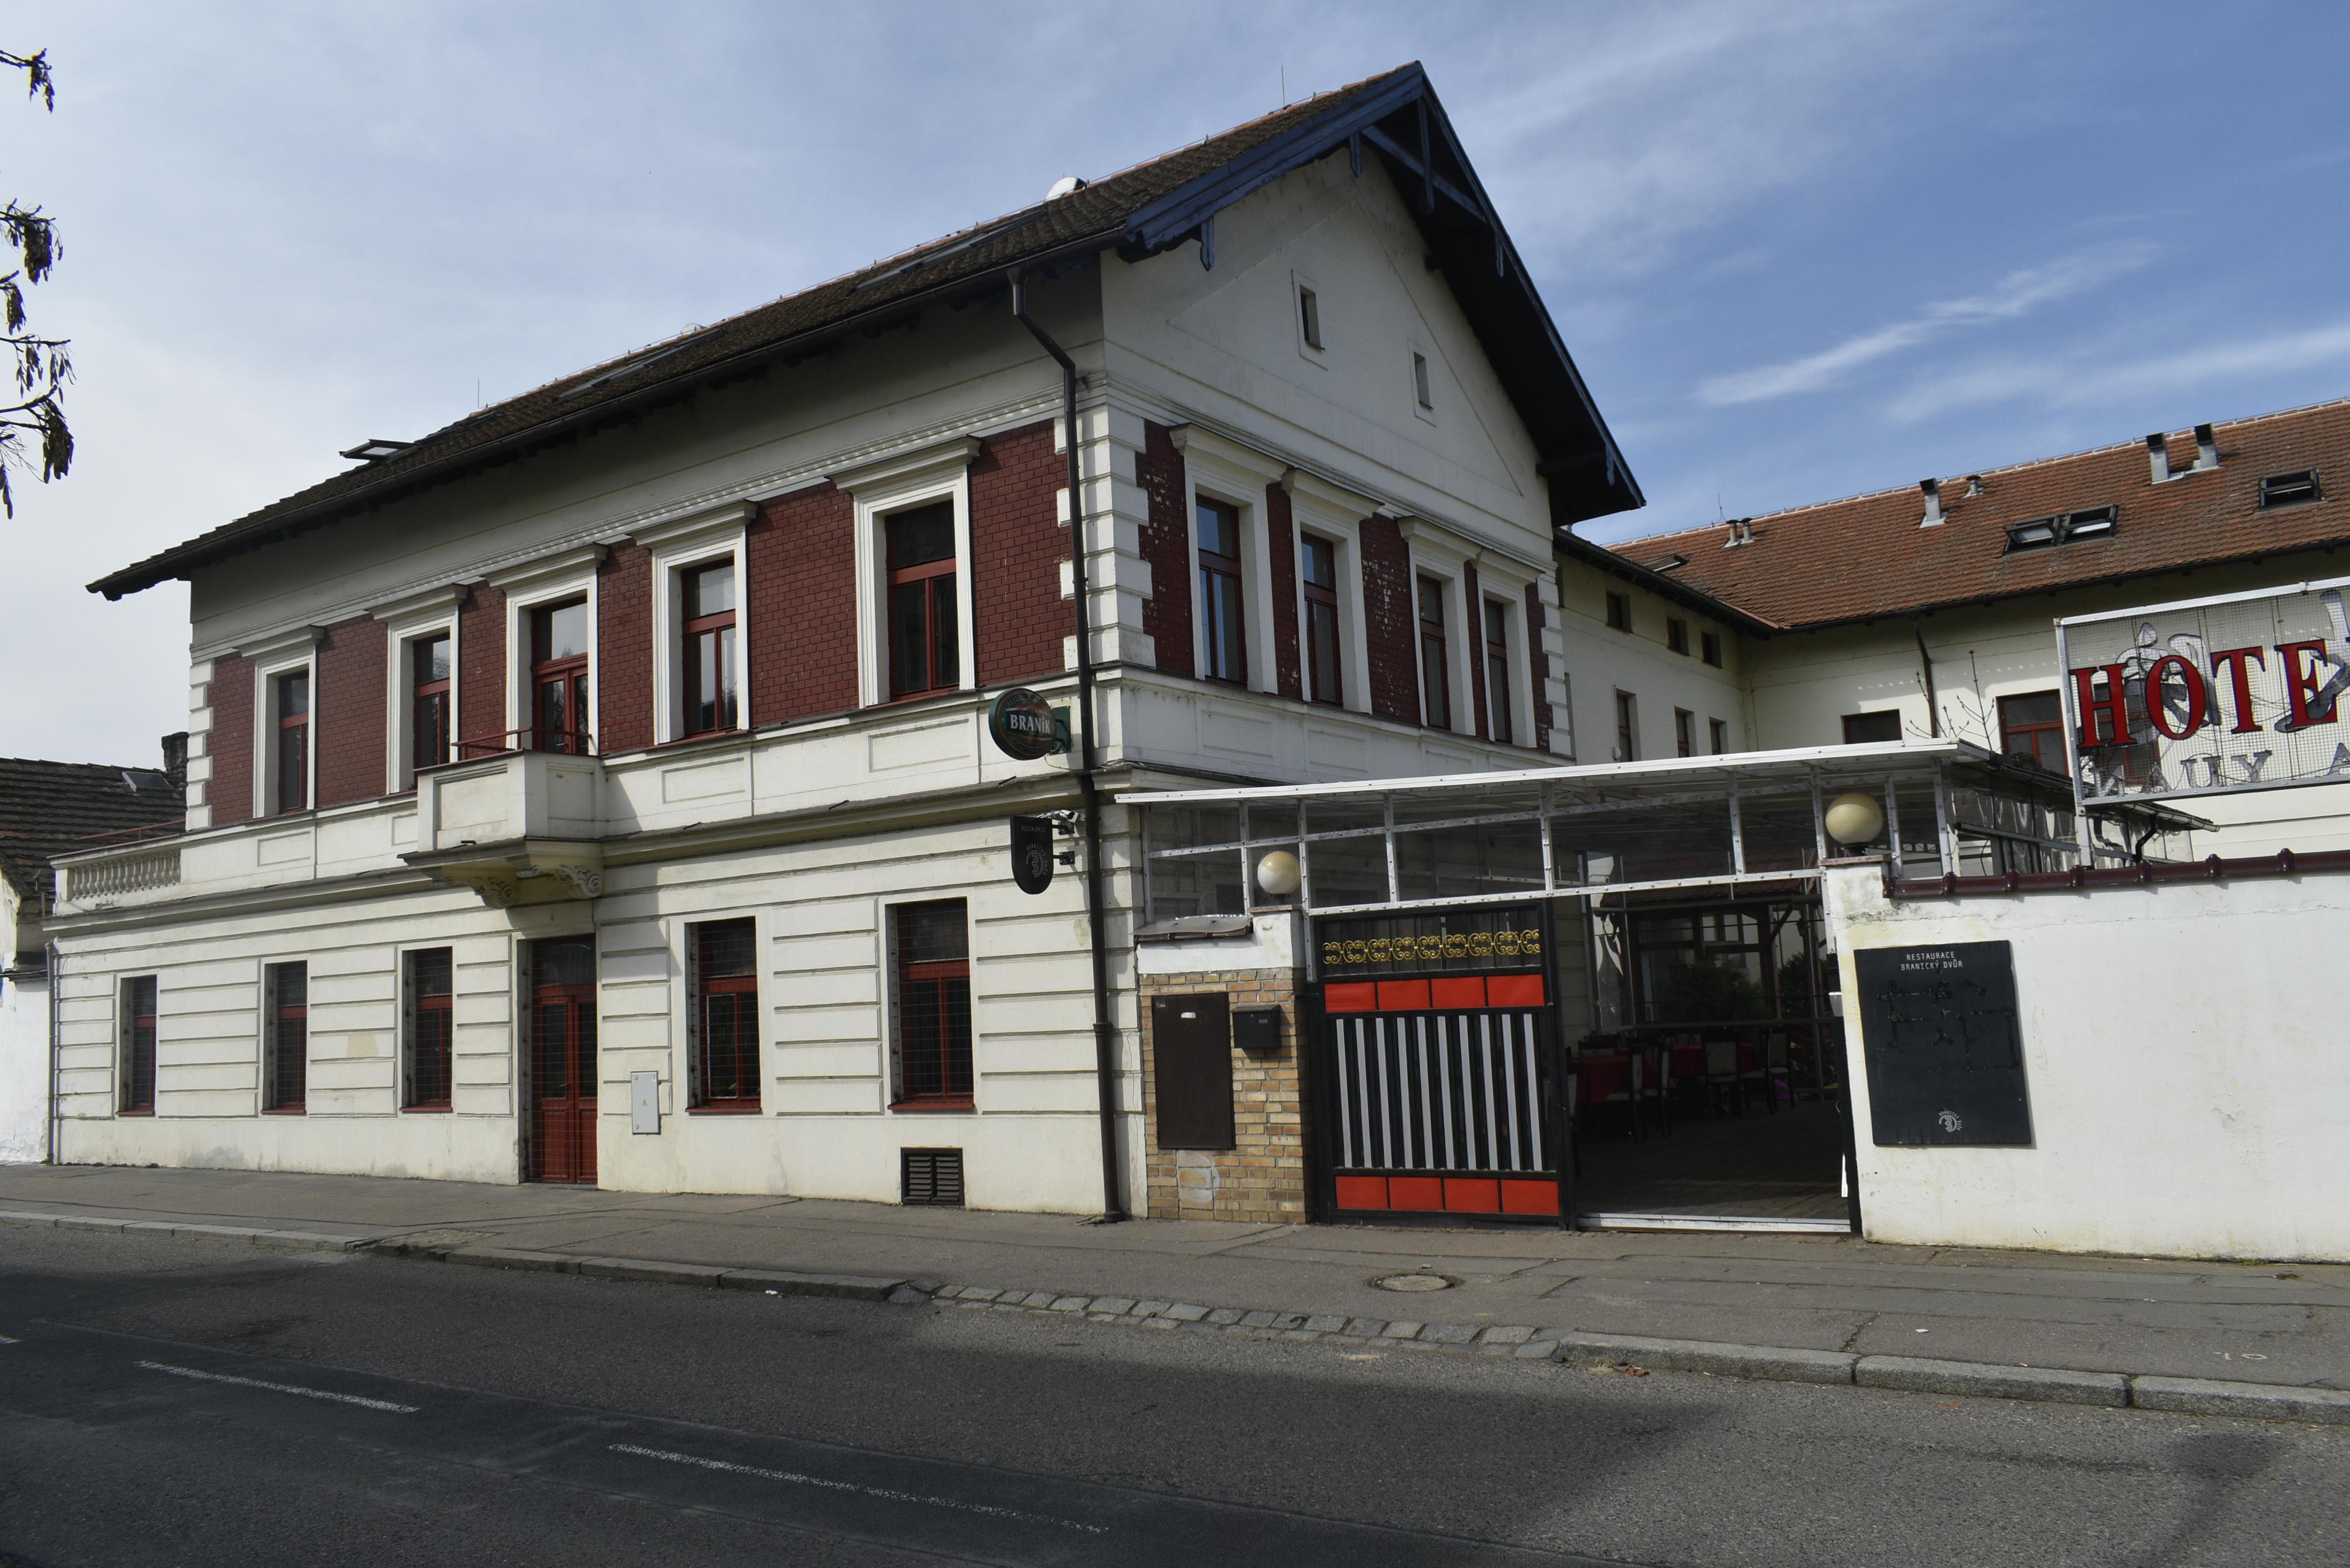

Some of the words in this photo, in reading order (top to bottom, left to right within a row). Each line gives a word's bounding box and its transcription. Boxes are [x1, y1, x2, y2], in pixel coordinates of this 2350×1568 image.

[2068, 637, 2350, 749] HOTE
[1906, 951, 1955, 961] RESTAURACE
[1901, 960, 1939, 971] BRANICKÝ
[1943, 959, 1963, 968] DVŮR
